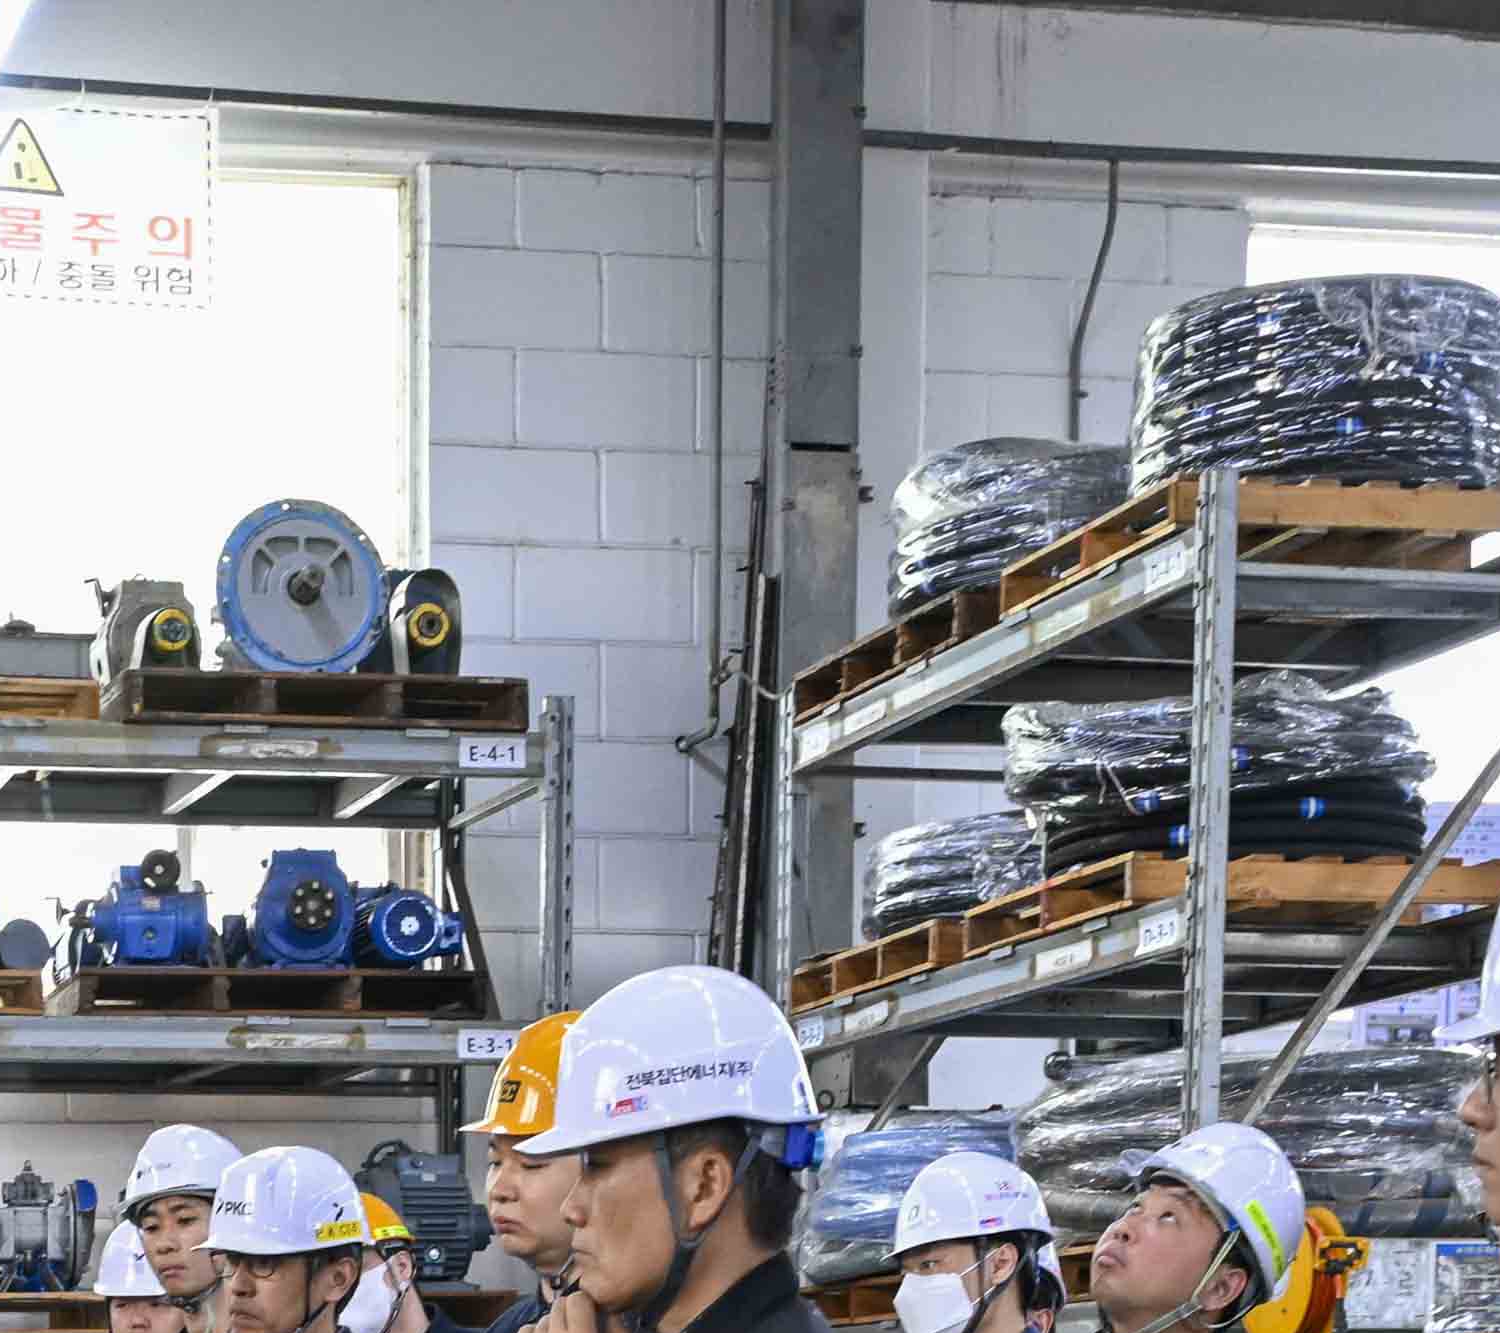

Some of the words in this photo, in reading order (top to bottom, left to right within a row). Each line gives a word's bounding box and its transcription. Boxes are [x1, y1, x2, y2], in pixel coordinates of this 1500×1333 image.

[58, 261, 116, 291] 충돌
[134, 265, 193, 295] 위험
[469, 745, 517, 763] E-4-1
[467, 1036, 514, 1054] E-3-1
